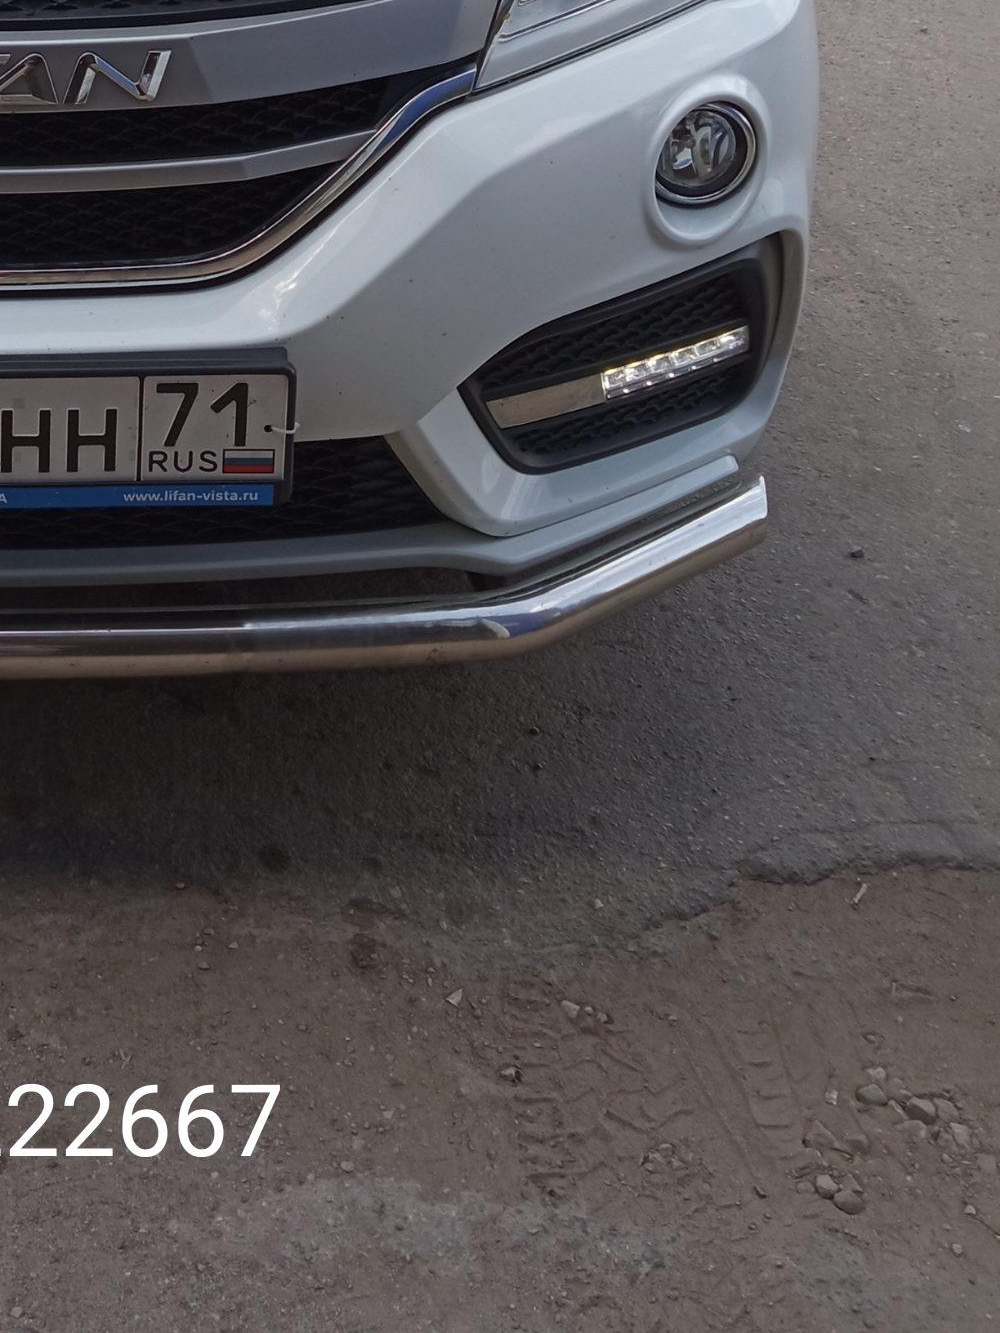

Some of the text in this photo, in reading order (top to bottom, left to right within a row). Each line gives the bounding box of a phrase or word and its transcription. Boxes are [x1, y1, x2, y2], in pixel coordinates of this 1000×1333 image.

[156, 379, 250, 448] 71
[148, 449, 218, 473] RUS
[123, 489, 258, 503] www.lifan-vista.ru
